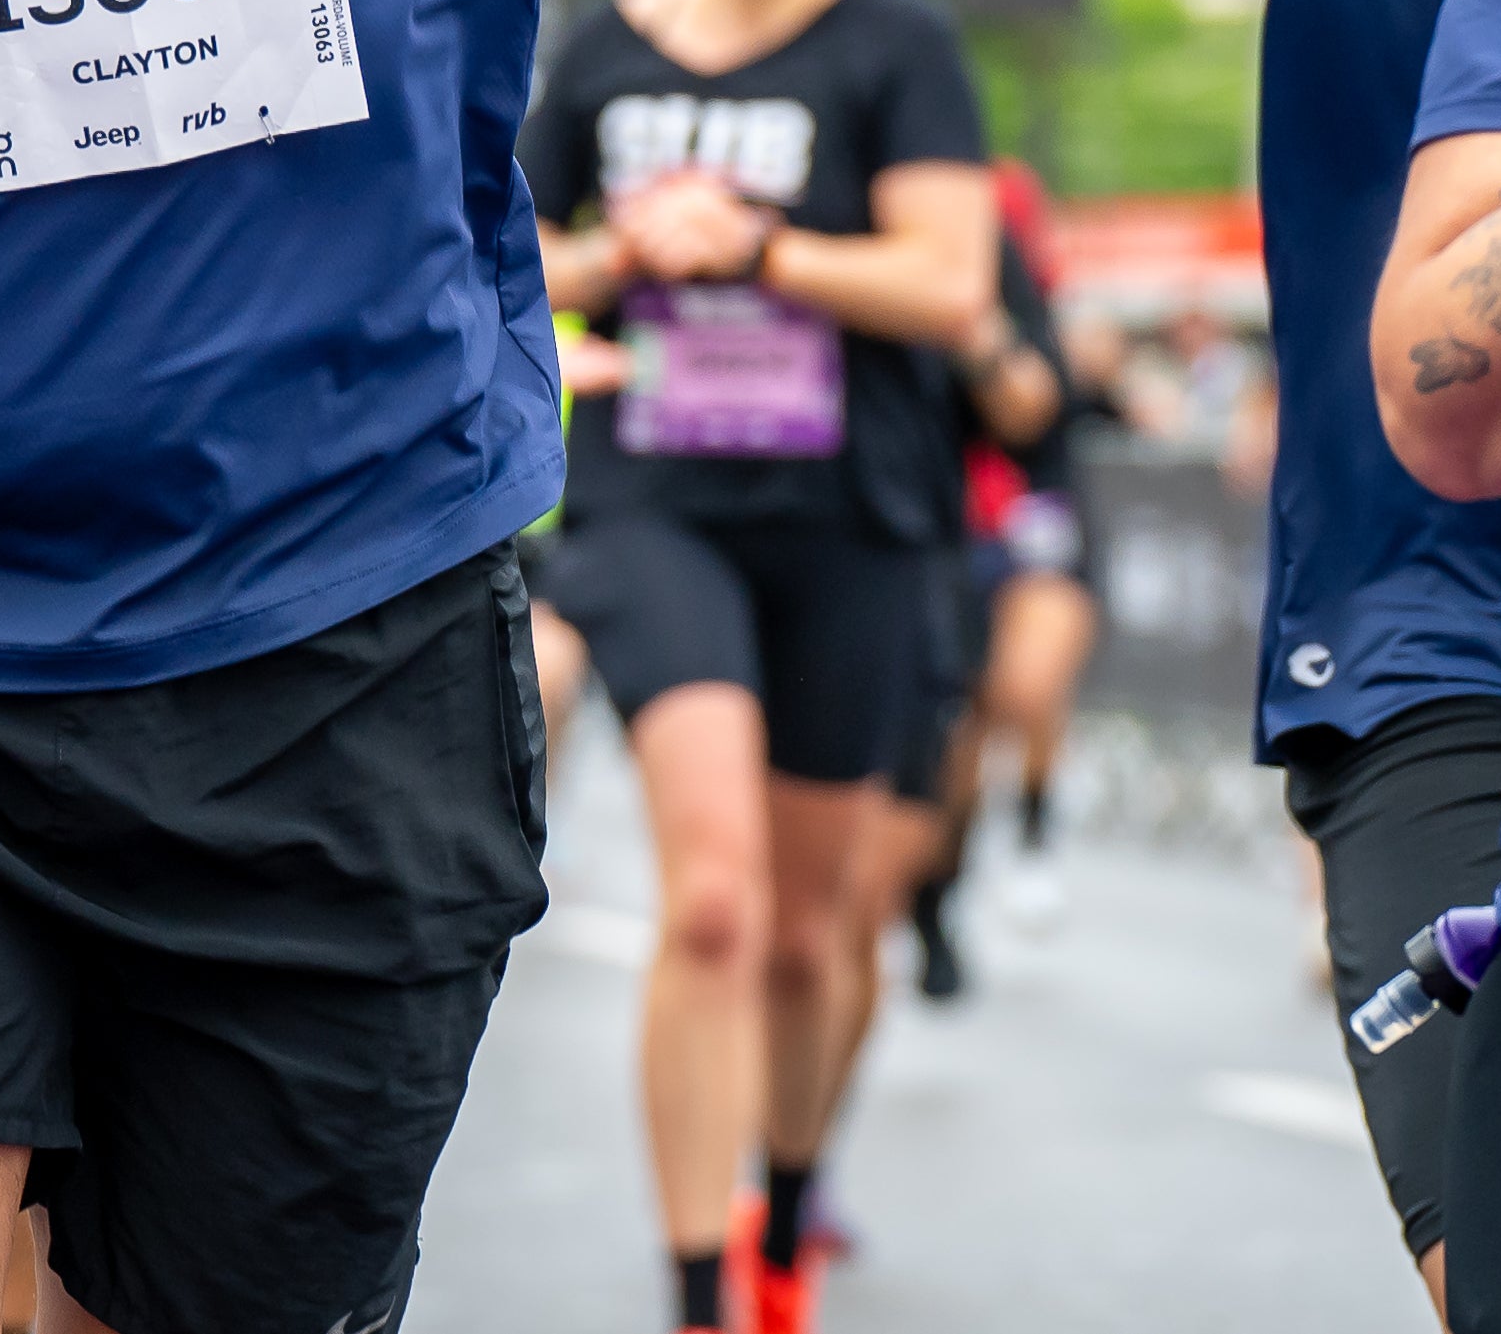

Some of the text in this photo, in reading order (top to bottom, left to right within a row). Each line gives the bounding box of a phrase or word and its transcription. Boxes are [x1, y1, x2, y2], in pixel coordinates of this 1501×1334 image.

[311, 2, 335, 64] 13063
[71, 35, 219, 85] CLAYTON
[74, 124, 141, 150] Jeep
